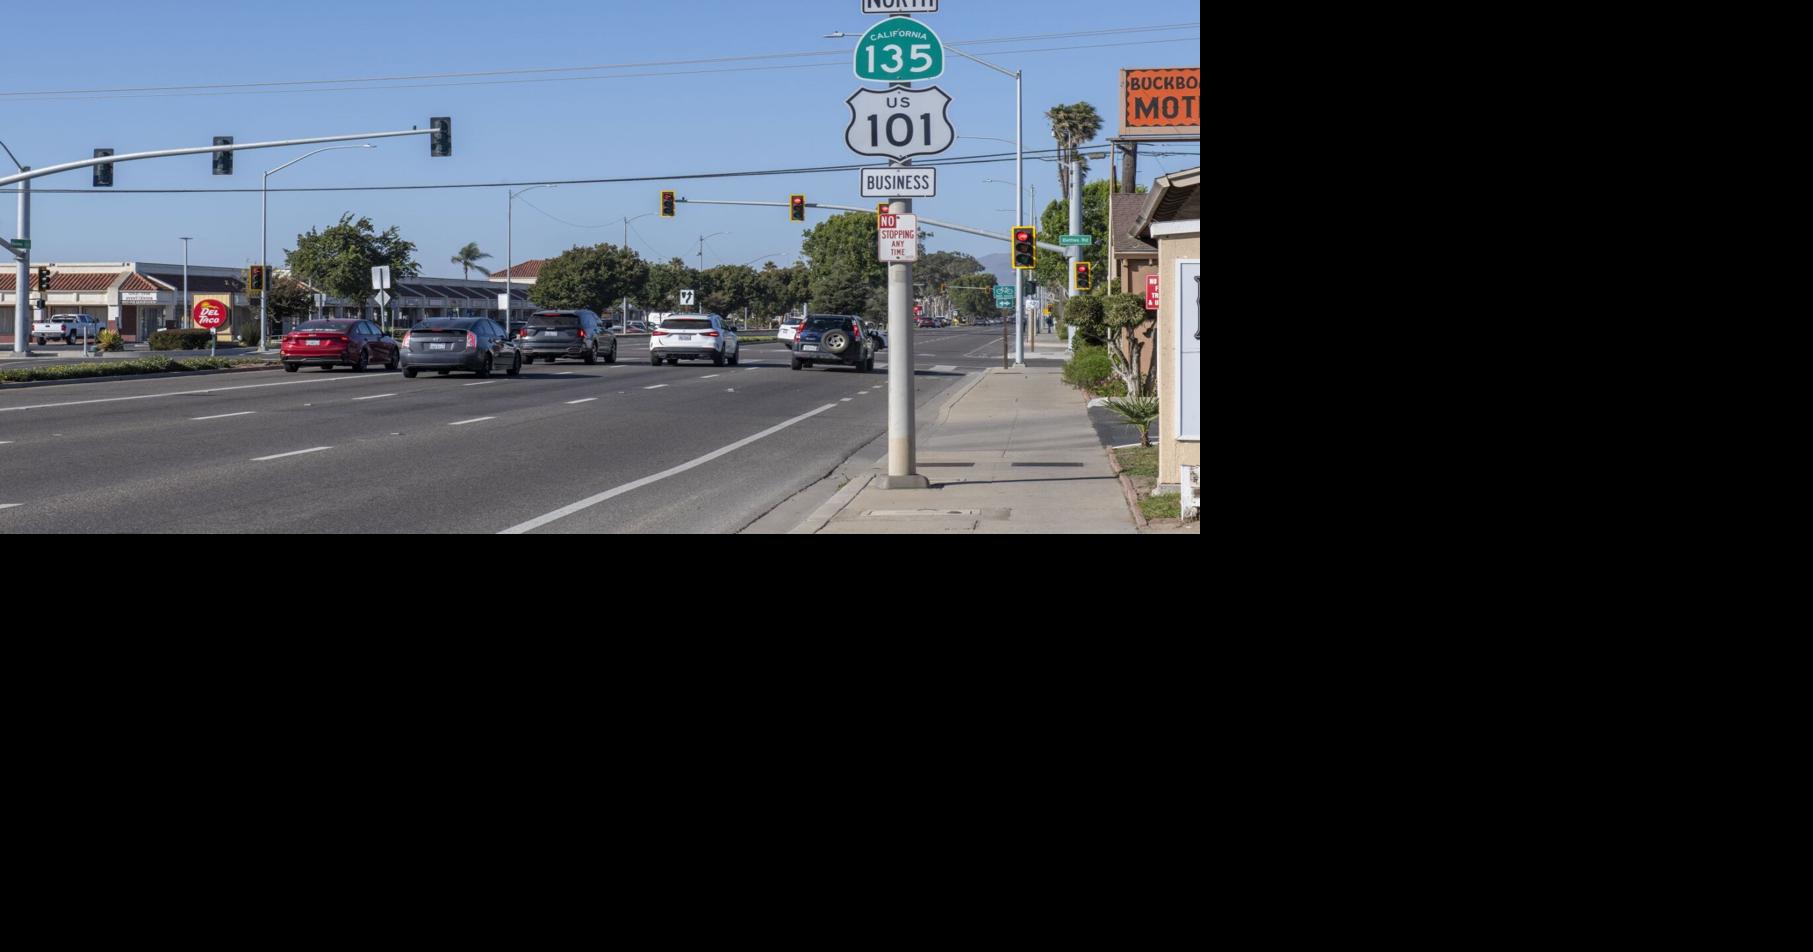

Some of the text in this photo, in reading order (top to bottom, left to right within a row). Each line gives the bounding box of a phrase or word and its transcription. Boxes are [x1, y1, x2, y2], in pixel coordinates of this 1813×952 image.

[870, 30, 927, 41] CALIFORNIA
[865, 44, 933, 73] 135
[1130, 76, 1200, 90] BUCKBO
[886, 97, 910, 108] US
[1134, 96, 1200, 119] MOT
[867, 113, 931, 147] 101
[867, 175, 930, 190] BUSINESS
[881, 216, 895, 227] NO
[882, 230, 914, 239] STOPPING
